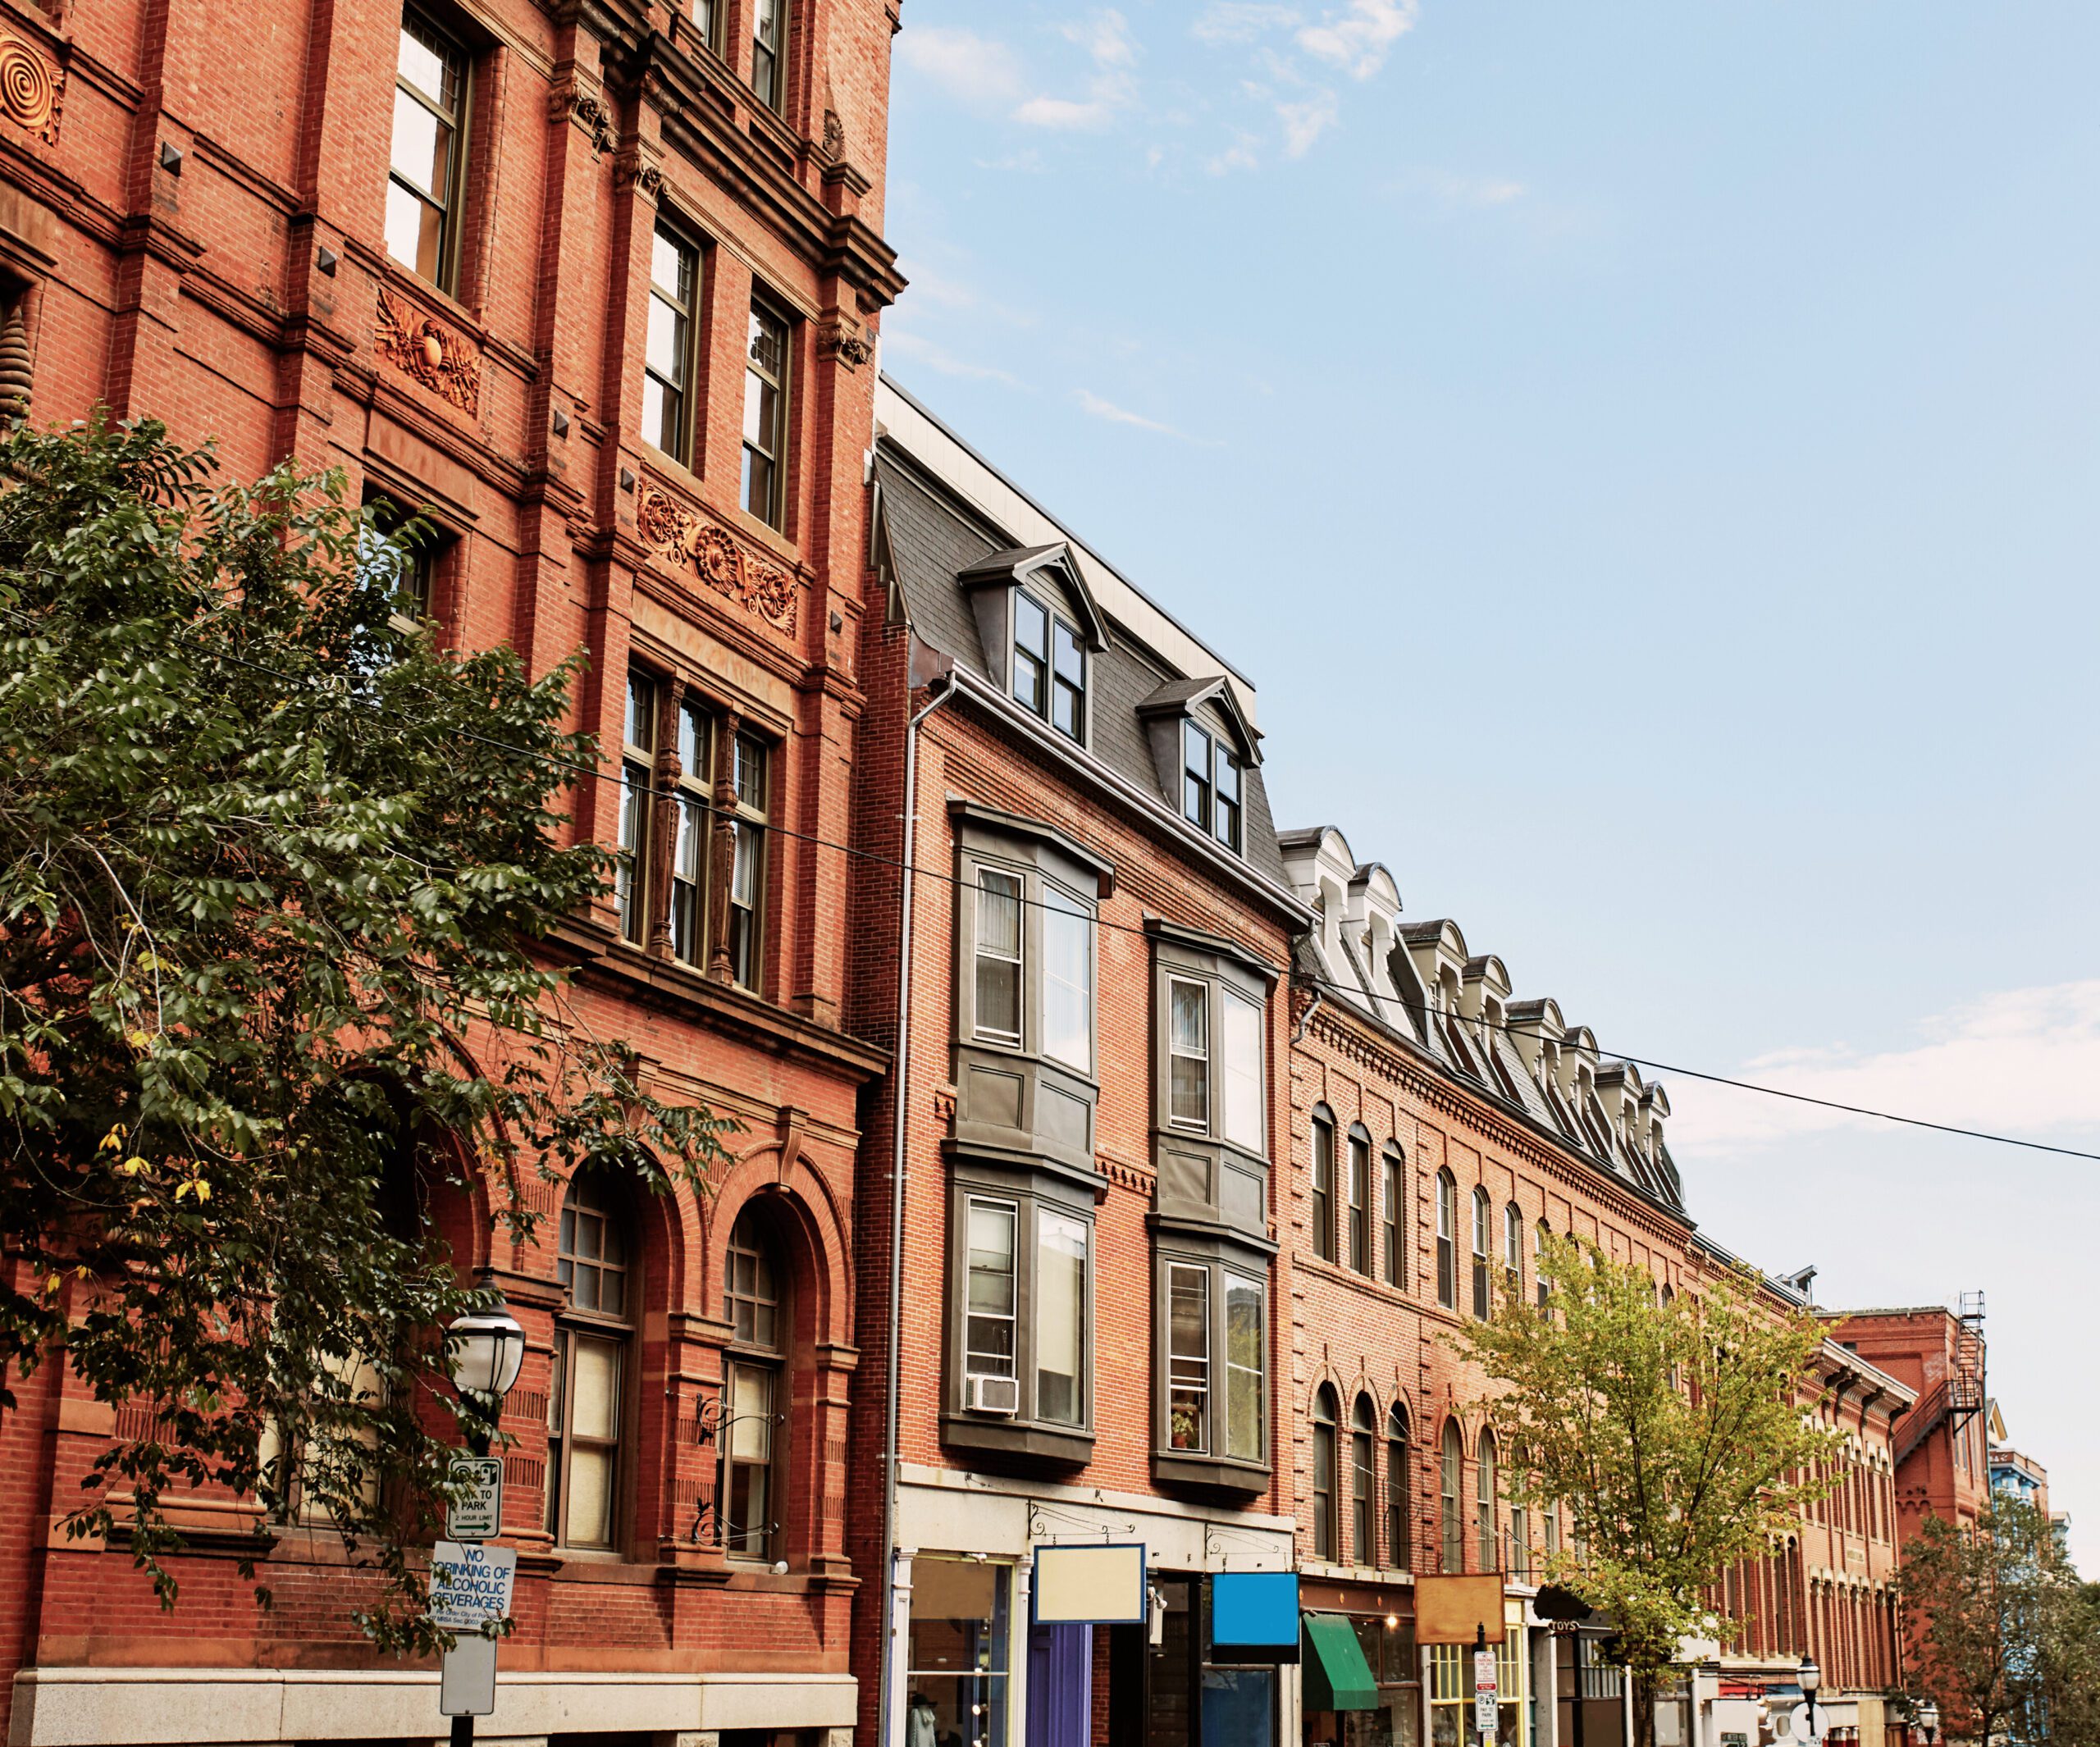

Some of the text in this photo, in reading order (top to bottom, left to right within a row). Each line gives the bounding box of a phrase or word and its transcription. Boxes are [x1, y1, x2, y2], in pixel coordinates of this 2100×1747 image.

[480, 1489, 492, 1499] TO
[461, 1501, 486, 1511] PARK
[466, 1549, 485, 1562] NO
[436, 1561, 511, 1580] DRINKING OF
[436, 1578, 506, 1595] ALCOHOLIC
[1550, 1621, 1576, 1631] TOYS
